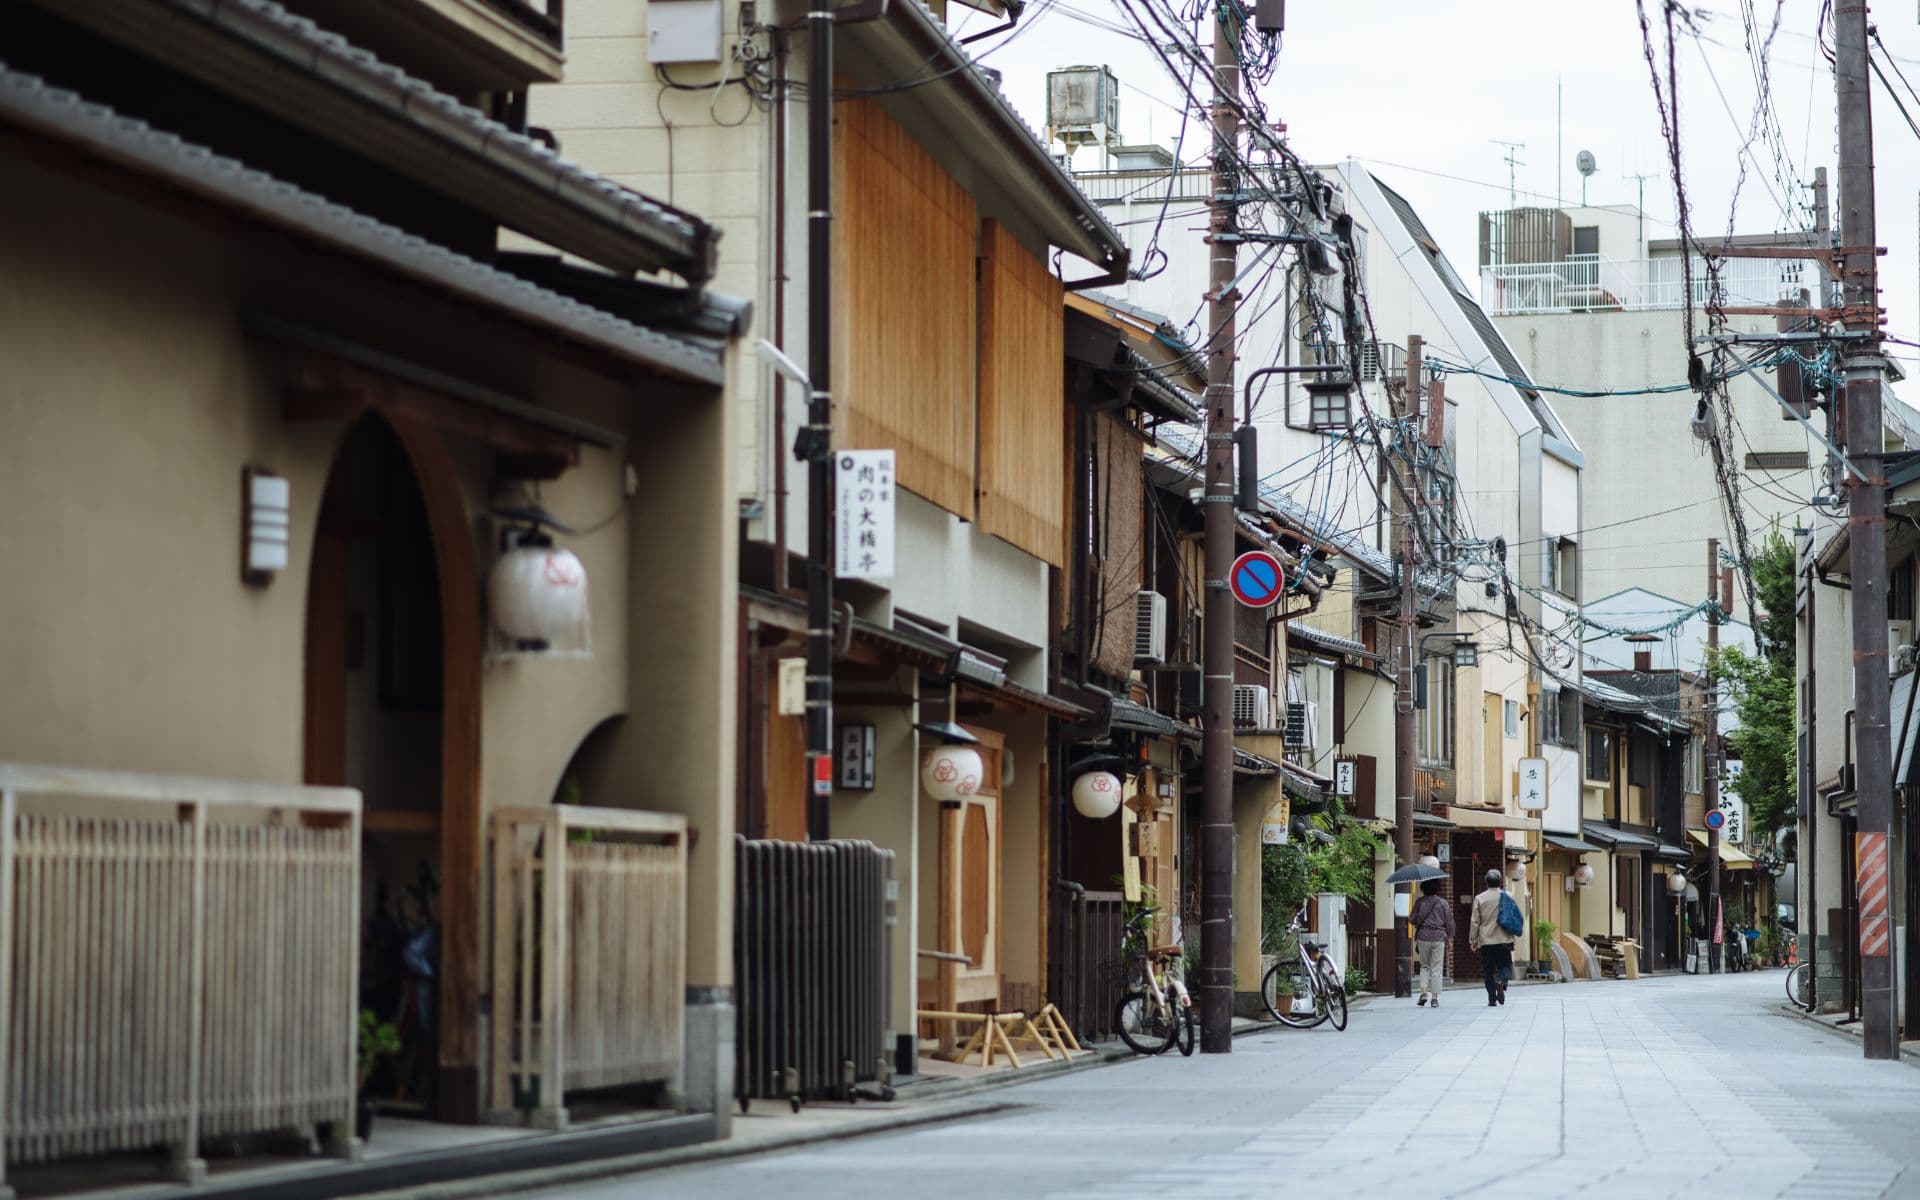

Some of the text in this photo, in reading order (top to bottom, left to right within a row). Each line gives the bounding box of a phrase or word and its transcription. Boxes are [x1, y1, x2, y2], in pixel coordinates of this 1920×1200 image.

[857, 464, 877, 573] 肉の大橋亭
[1340, 764, 1350, 793] 高よし
